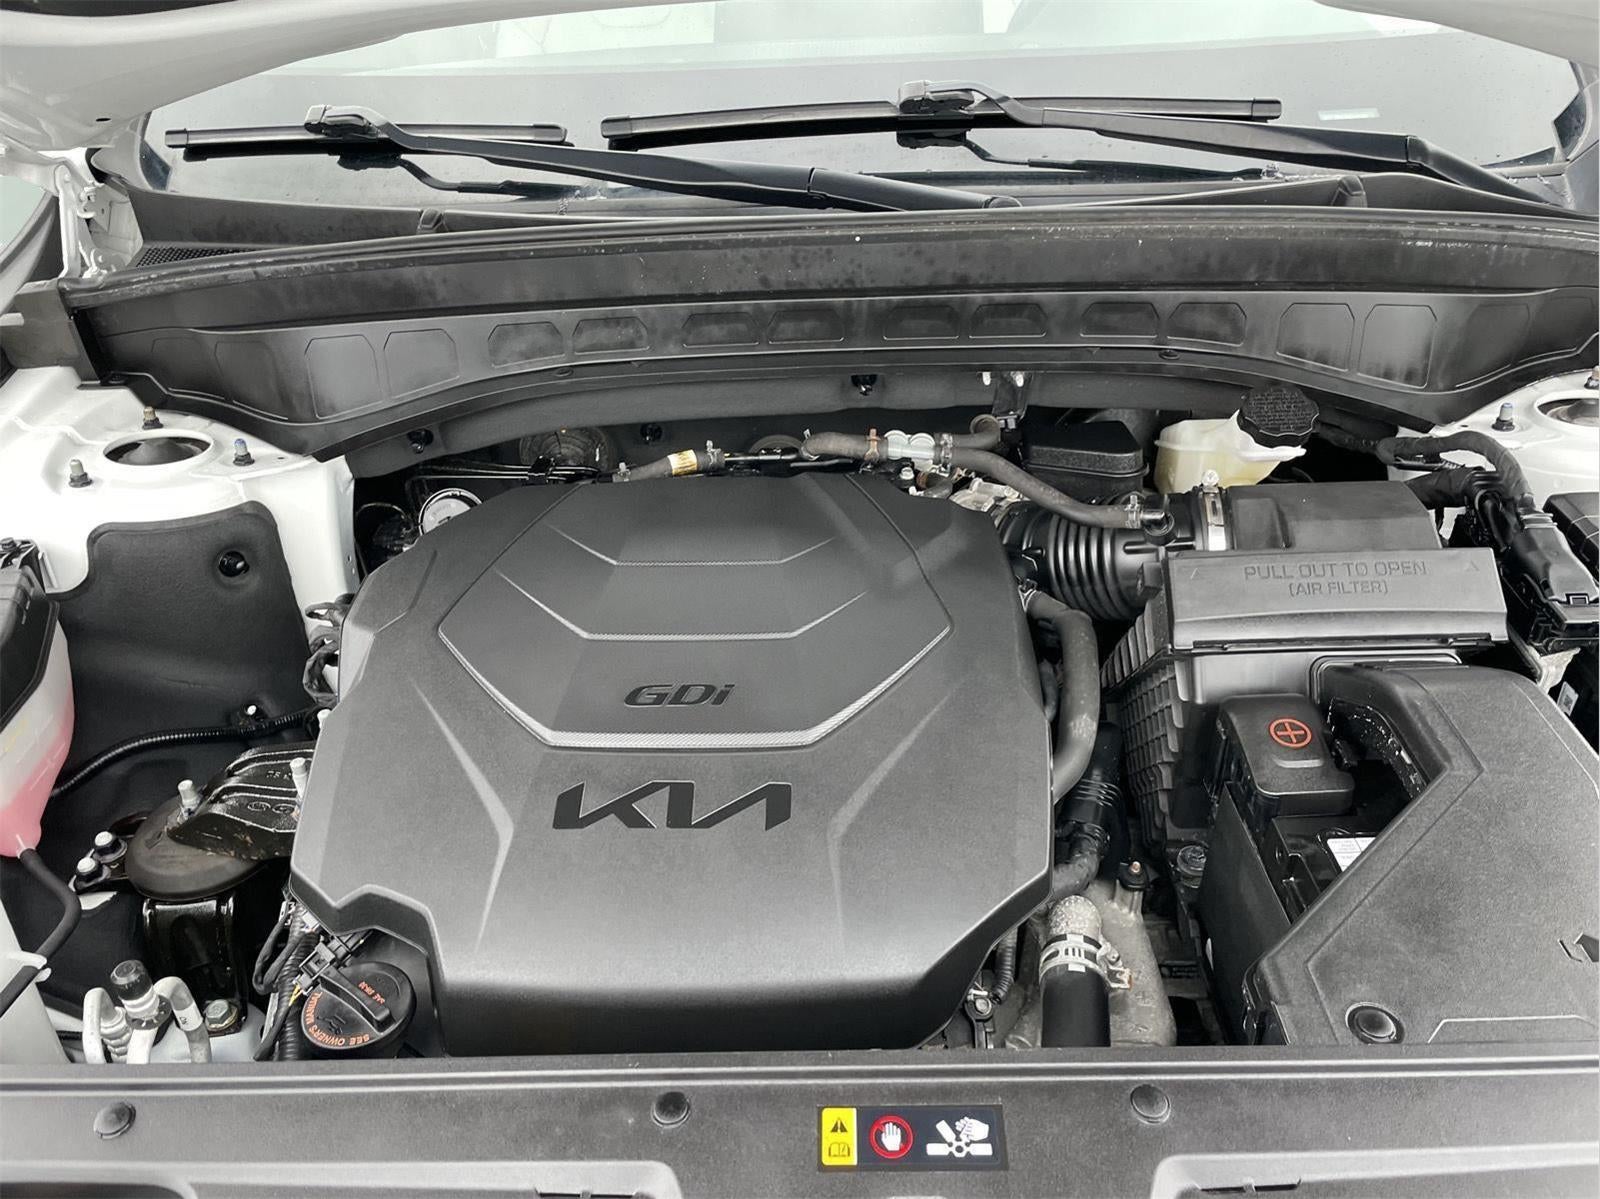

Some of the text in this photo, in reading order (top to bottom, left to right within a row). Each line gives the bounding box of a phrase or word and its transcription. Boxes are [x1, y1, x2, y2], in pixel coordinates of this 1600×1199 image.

[1243, 560, 1427, 581] PULL OUT TO OPEN
[1288, 579, 1389, 597] (AIR FILTER)
[623, 683, 736, 707] GDi
[552, 780, 792, 831] KIA
[305, 991, 323, 1025] MANUAL
[349, 1033, 370, 1046] SEE
